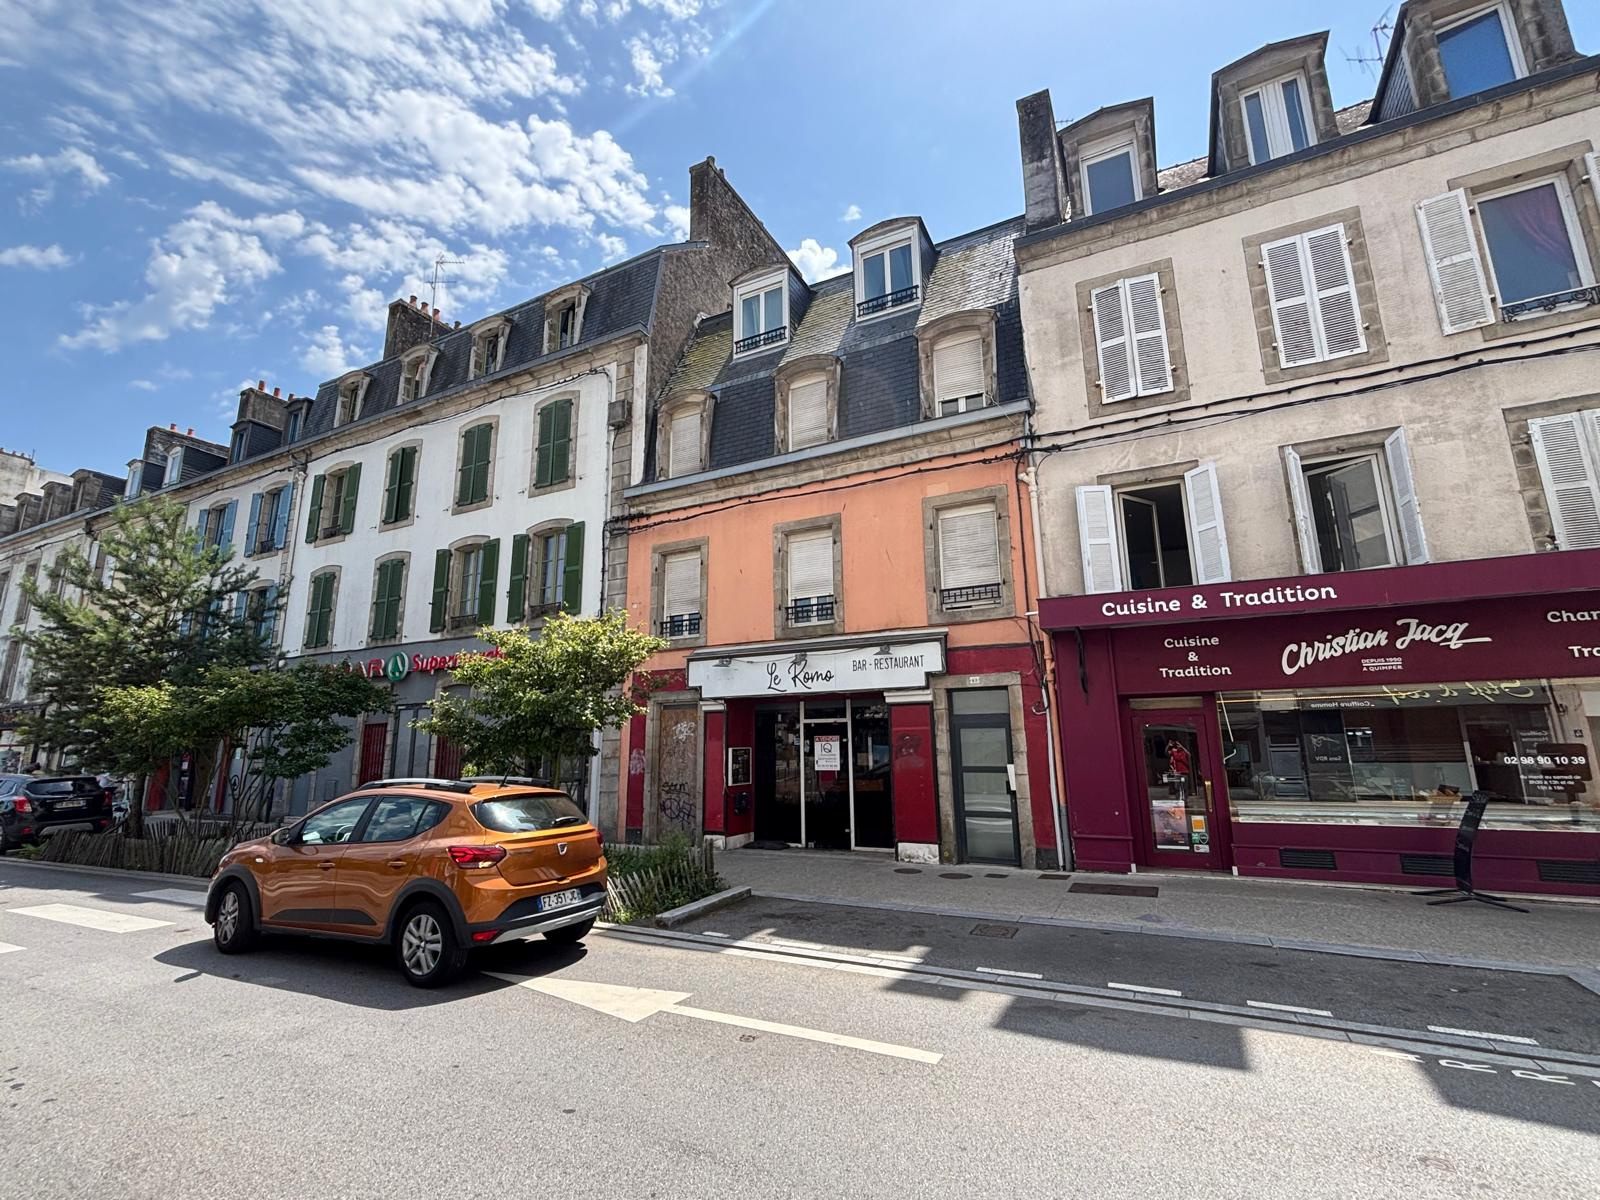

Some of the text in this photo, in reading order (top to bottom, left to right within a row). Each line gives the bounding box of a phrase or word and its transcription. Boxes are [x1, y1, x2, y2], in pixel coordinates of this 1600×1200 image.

[1102, 585, 1337, 616] Cuisine & Tradition
[1163, 634, 1220, 648] Cuisine
[1281, 618, 1493, 675] Christian Jacq
[852, 659, 867, 672] BAR
[874, 655, 924, 671] RESTAURANT
[1187, 651, 1199, 662] &
[766, 657, 835, 692] Le Romo
[1160, 664, 1232, 678] Tradition
[1503, 755, 1586, 765] 02 98 90 10 39
